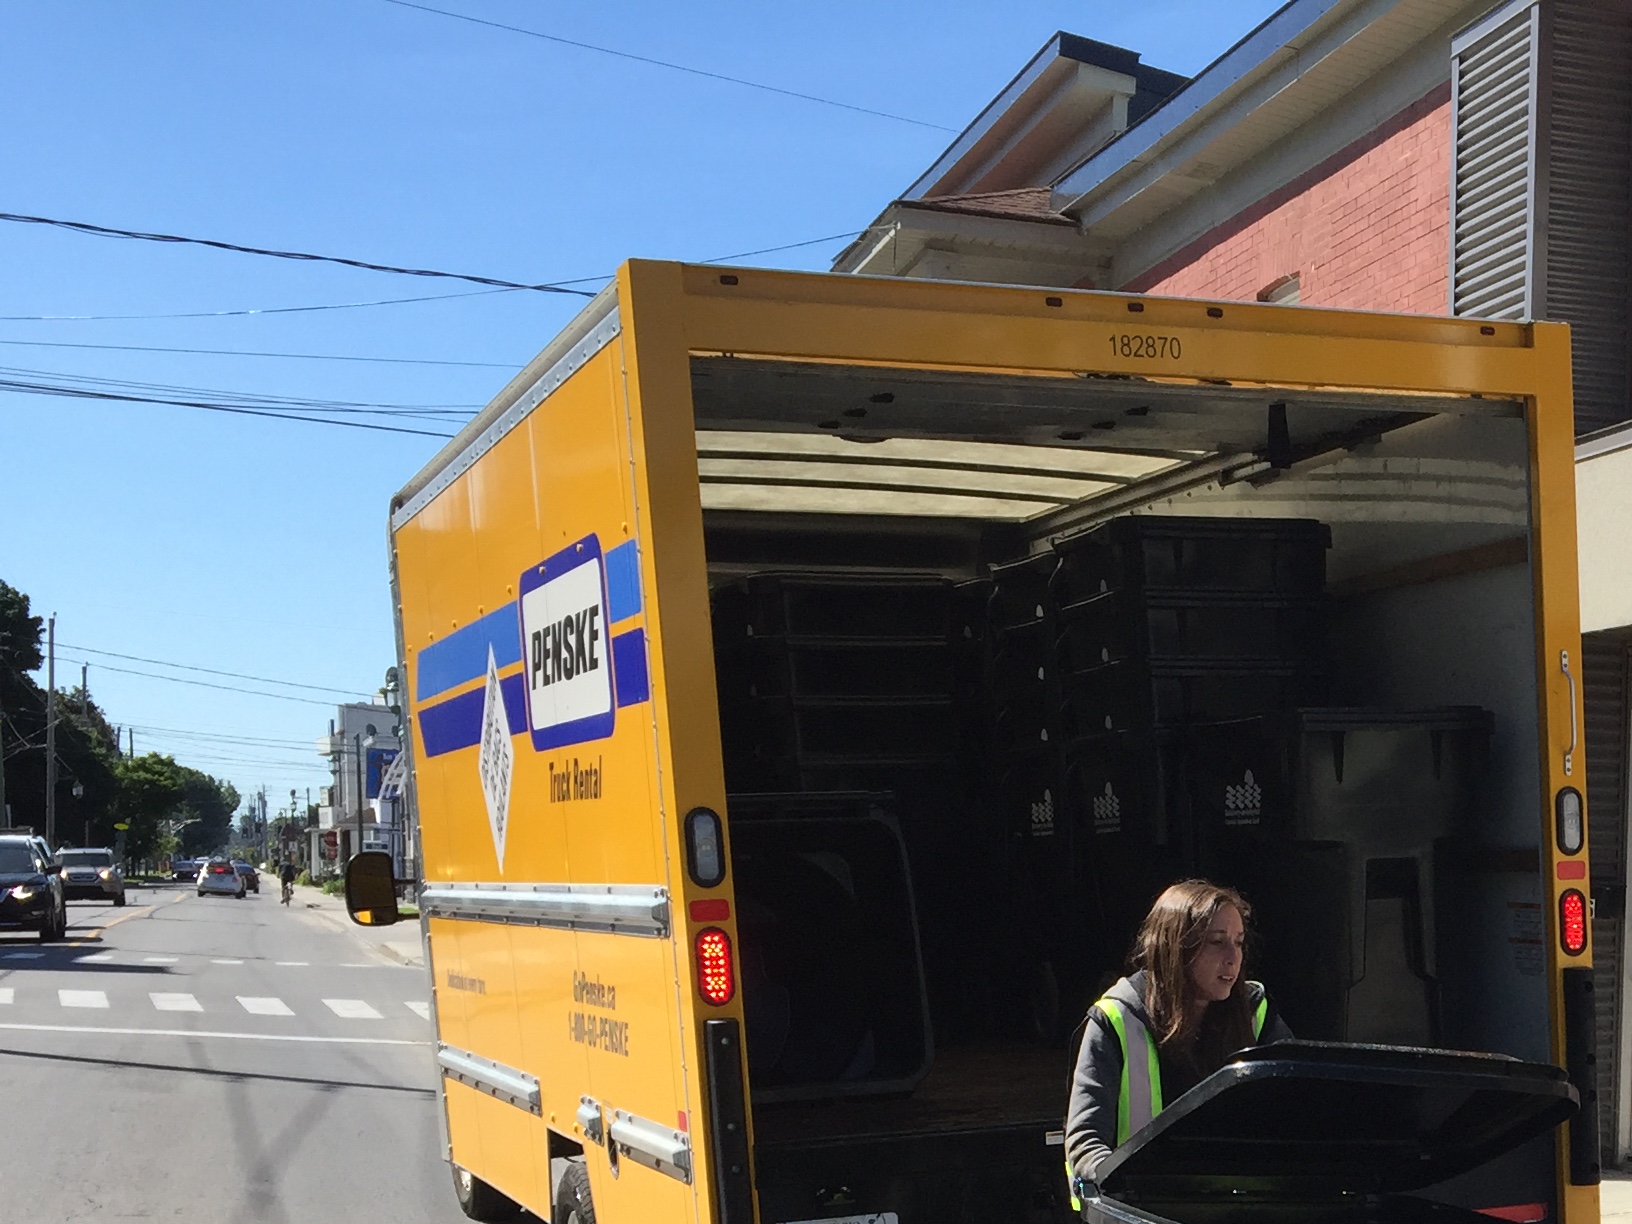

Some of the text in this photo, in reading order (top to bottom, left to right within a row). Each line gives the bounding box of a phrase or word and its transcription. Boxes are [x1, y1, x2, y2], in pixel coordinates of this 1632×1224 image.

[1108, 333, 1182, 360] 182870
[531, 603, 600, 691] PENSKE
[548, 758, 572, 804] Truck
[573, 753, 602, 801] Rental
